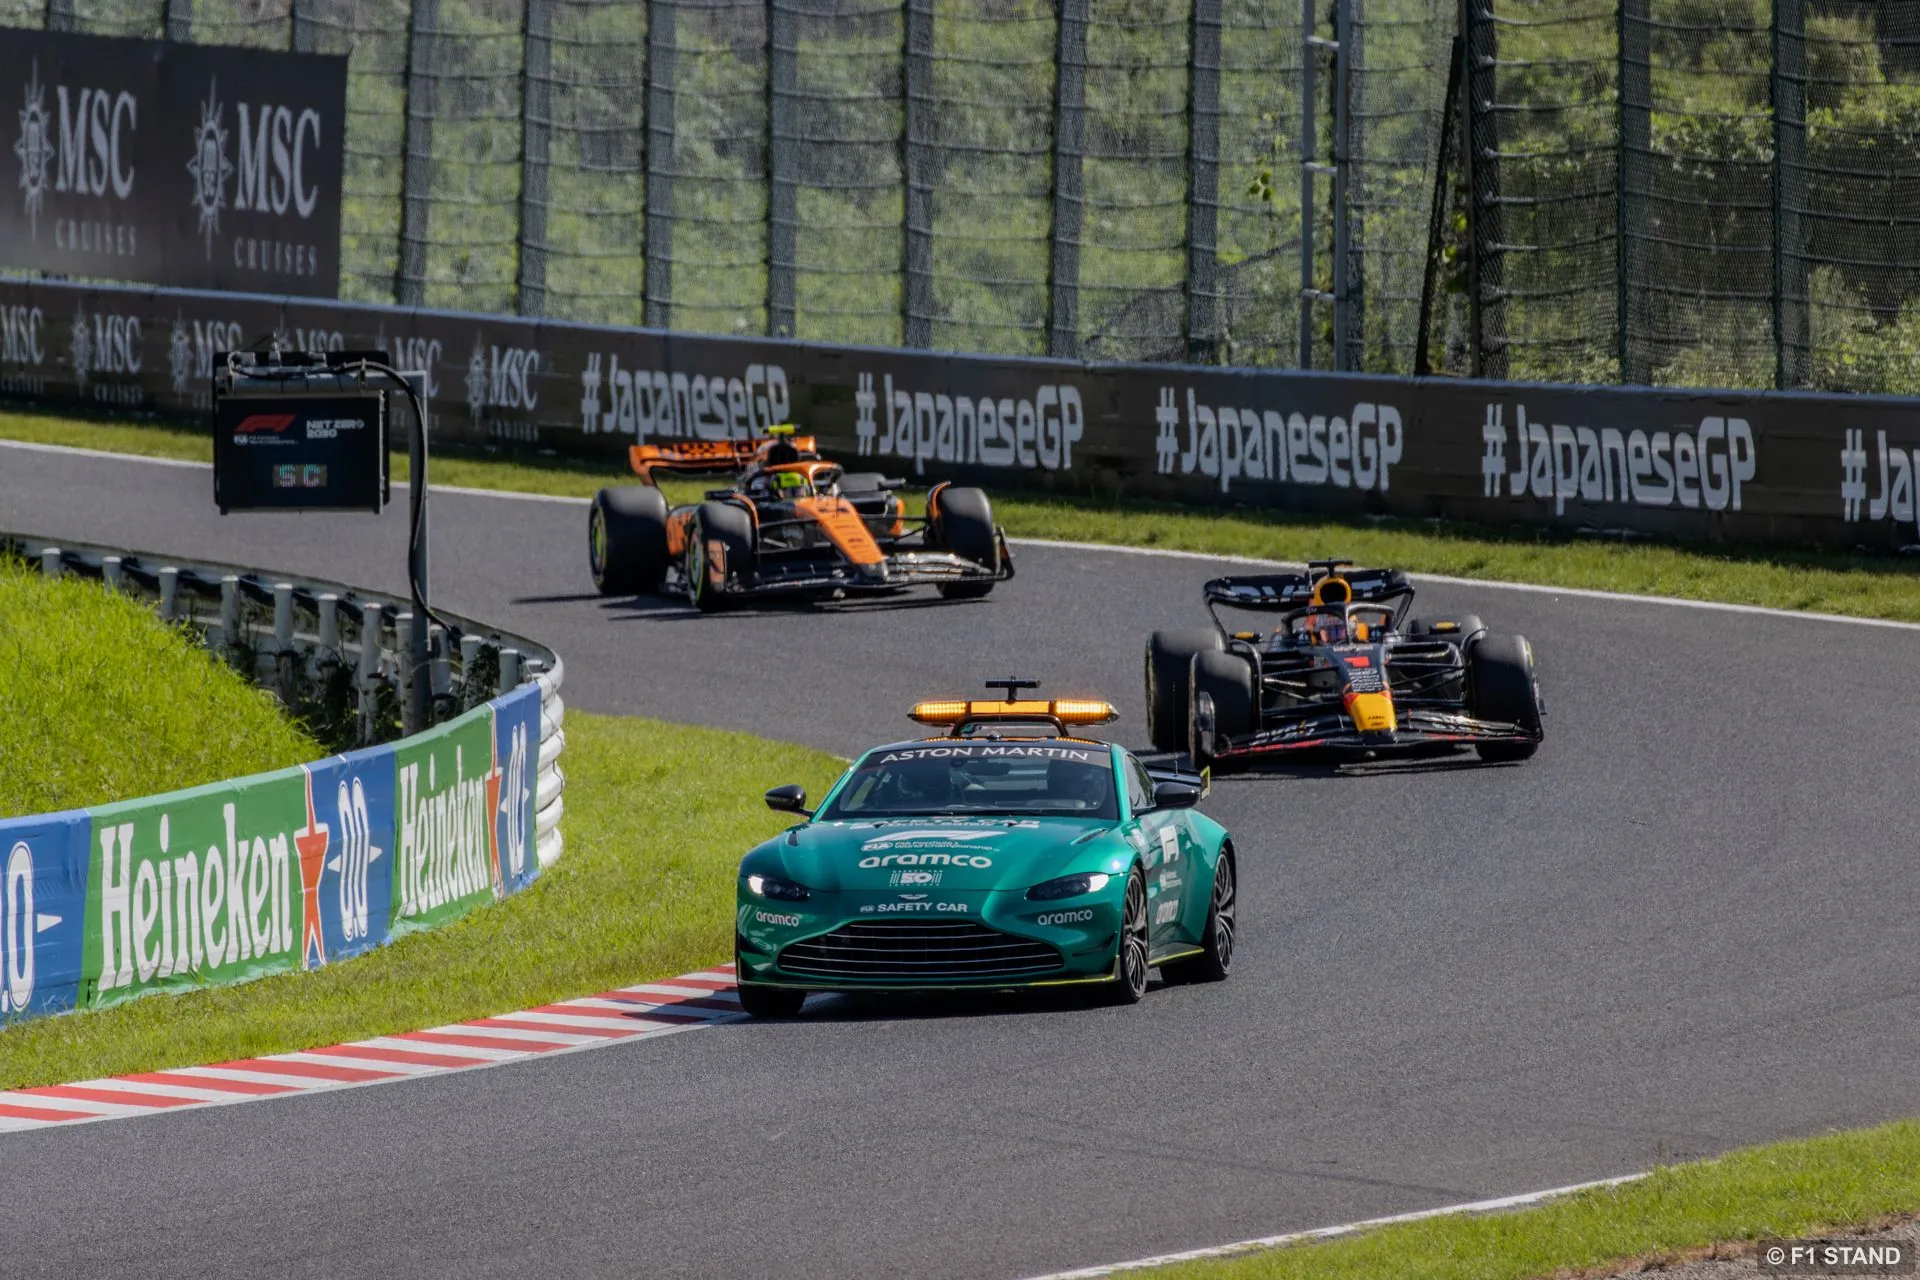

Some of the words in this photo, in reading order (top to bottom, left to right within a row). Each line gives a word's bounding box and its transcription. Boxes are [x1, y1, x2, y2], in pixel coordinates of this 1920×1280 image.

[56, 85, 137, 199] MSC
[234, 102, 320, 219] MSC
[56, 217, 136, 256] CRUISES
[234, 236, 317, 277] CRUISES
[0, 304, 45, 366] MSC
[94, 312, 143, 374] MSC
[489, 345, 541, 410] MSC
[581, 352, 790, 444] #JapaneseGP
[855, 371, 1084, 474] #JapaneseGP
[1156, 387, 1402, 492] #JapaneseGP
[1482, 403, 1756, 516] #JapaneseGP
[880, 747, 972, 764] ASTON
[982, 747, 1088, 761] MARTIN
[398, 744, 489, 916] Heineken
[858, 853, 993, 869] aramco
[98, 802, 294, 991] Heineken
[755, 911, 800, 928] aramco
[877, 902, 934, 912] SAFETY
[936, 902, 968, 912] CAR
[1038, 909, 1094, 926] aramco
